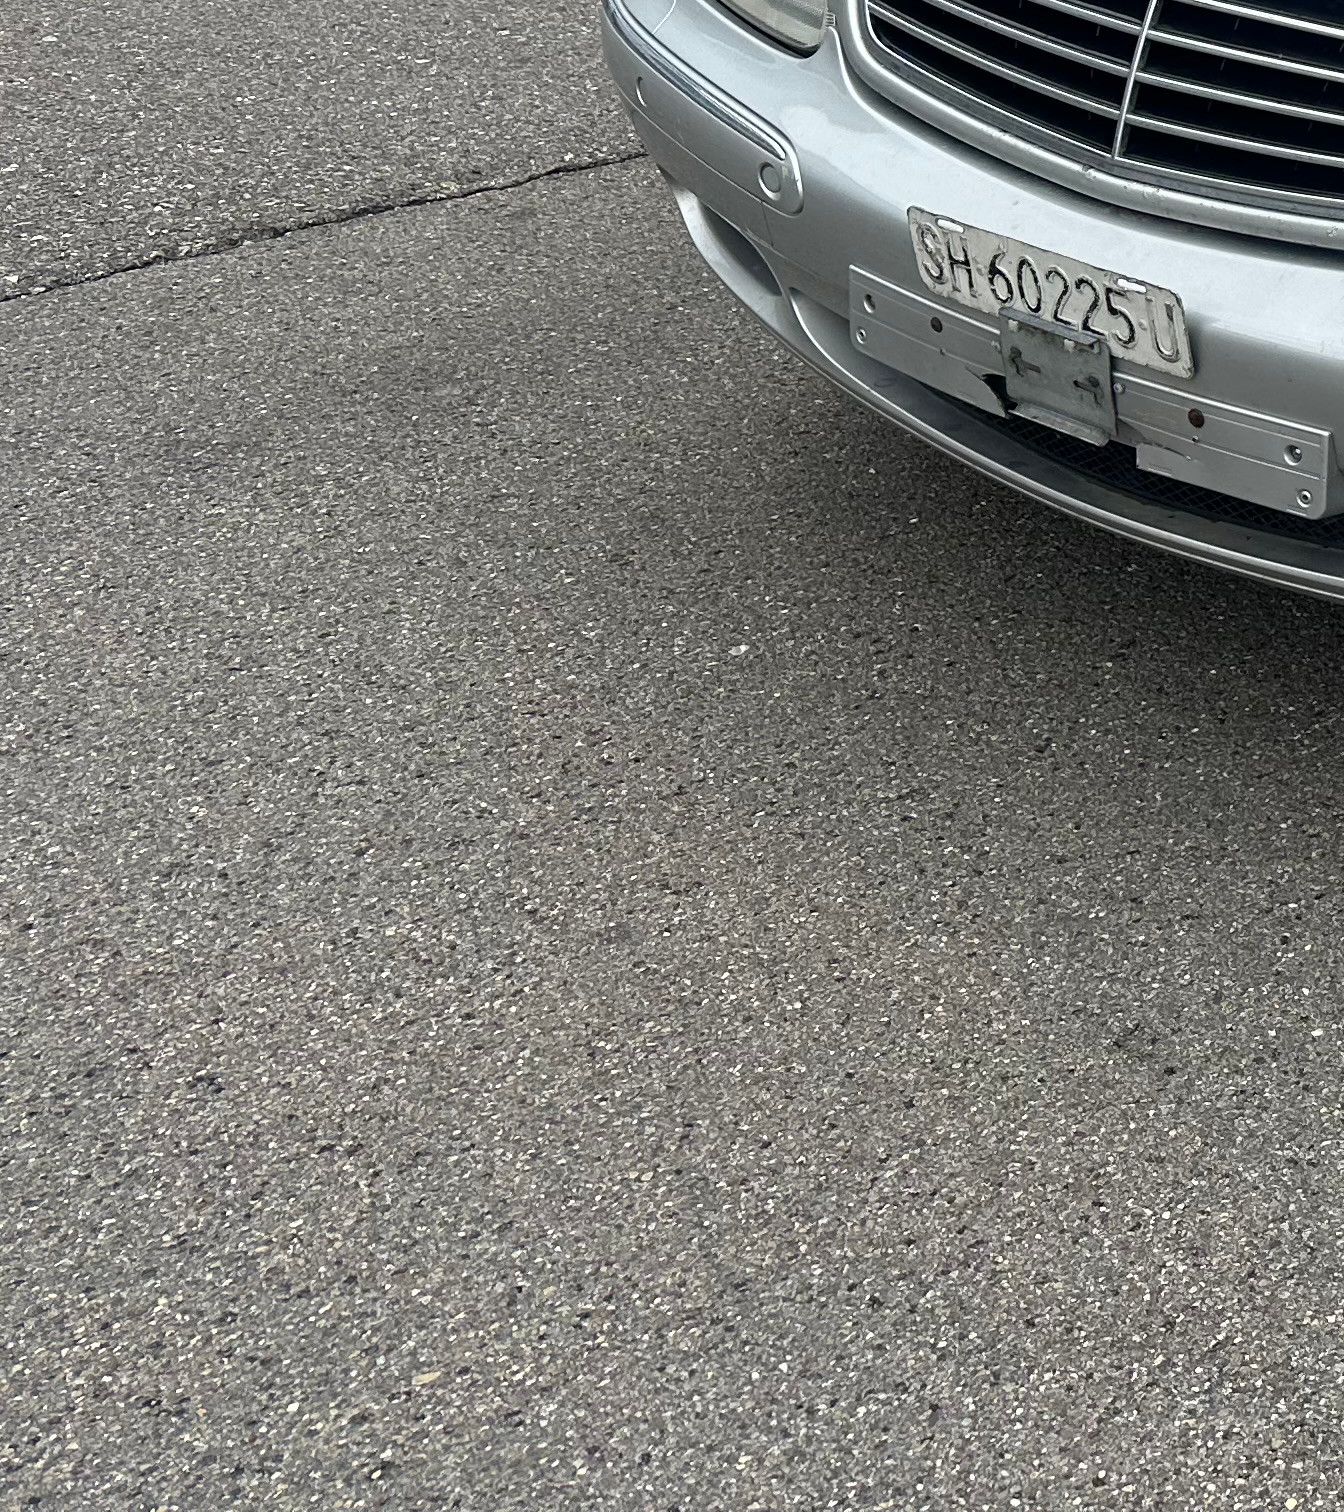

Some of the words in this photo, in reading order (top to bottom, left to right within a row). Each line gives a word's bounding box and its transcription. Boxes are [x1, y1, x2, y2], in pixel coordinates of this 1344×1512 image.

[918, 224, 977, 298] SH
[988, 251, 1136, 349] 60225
[1150, 299, 1182, 362] U
